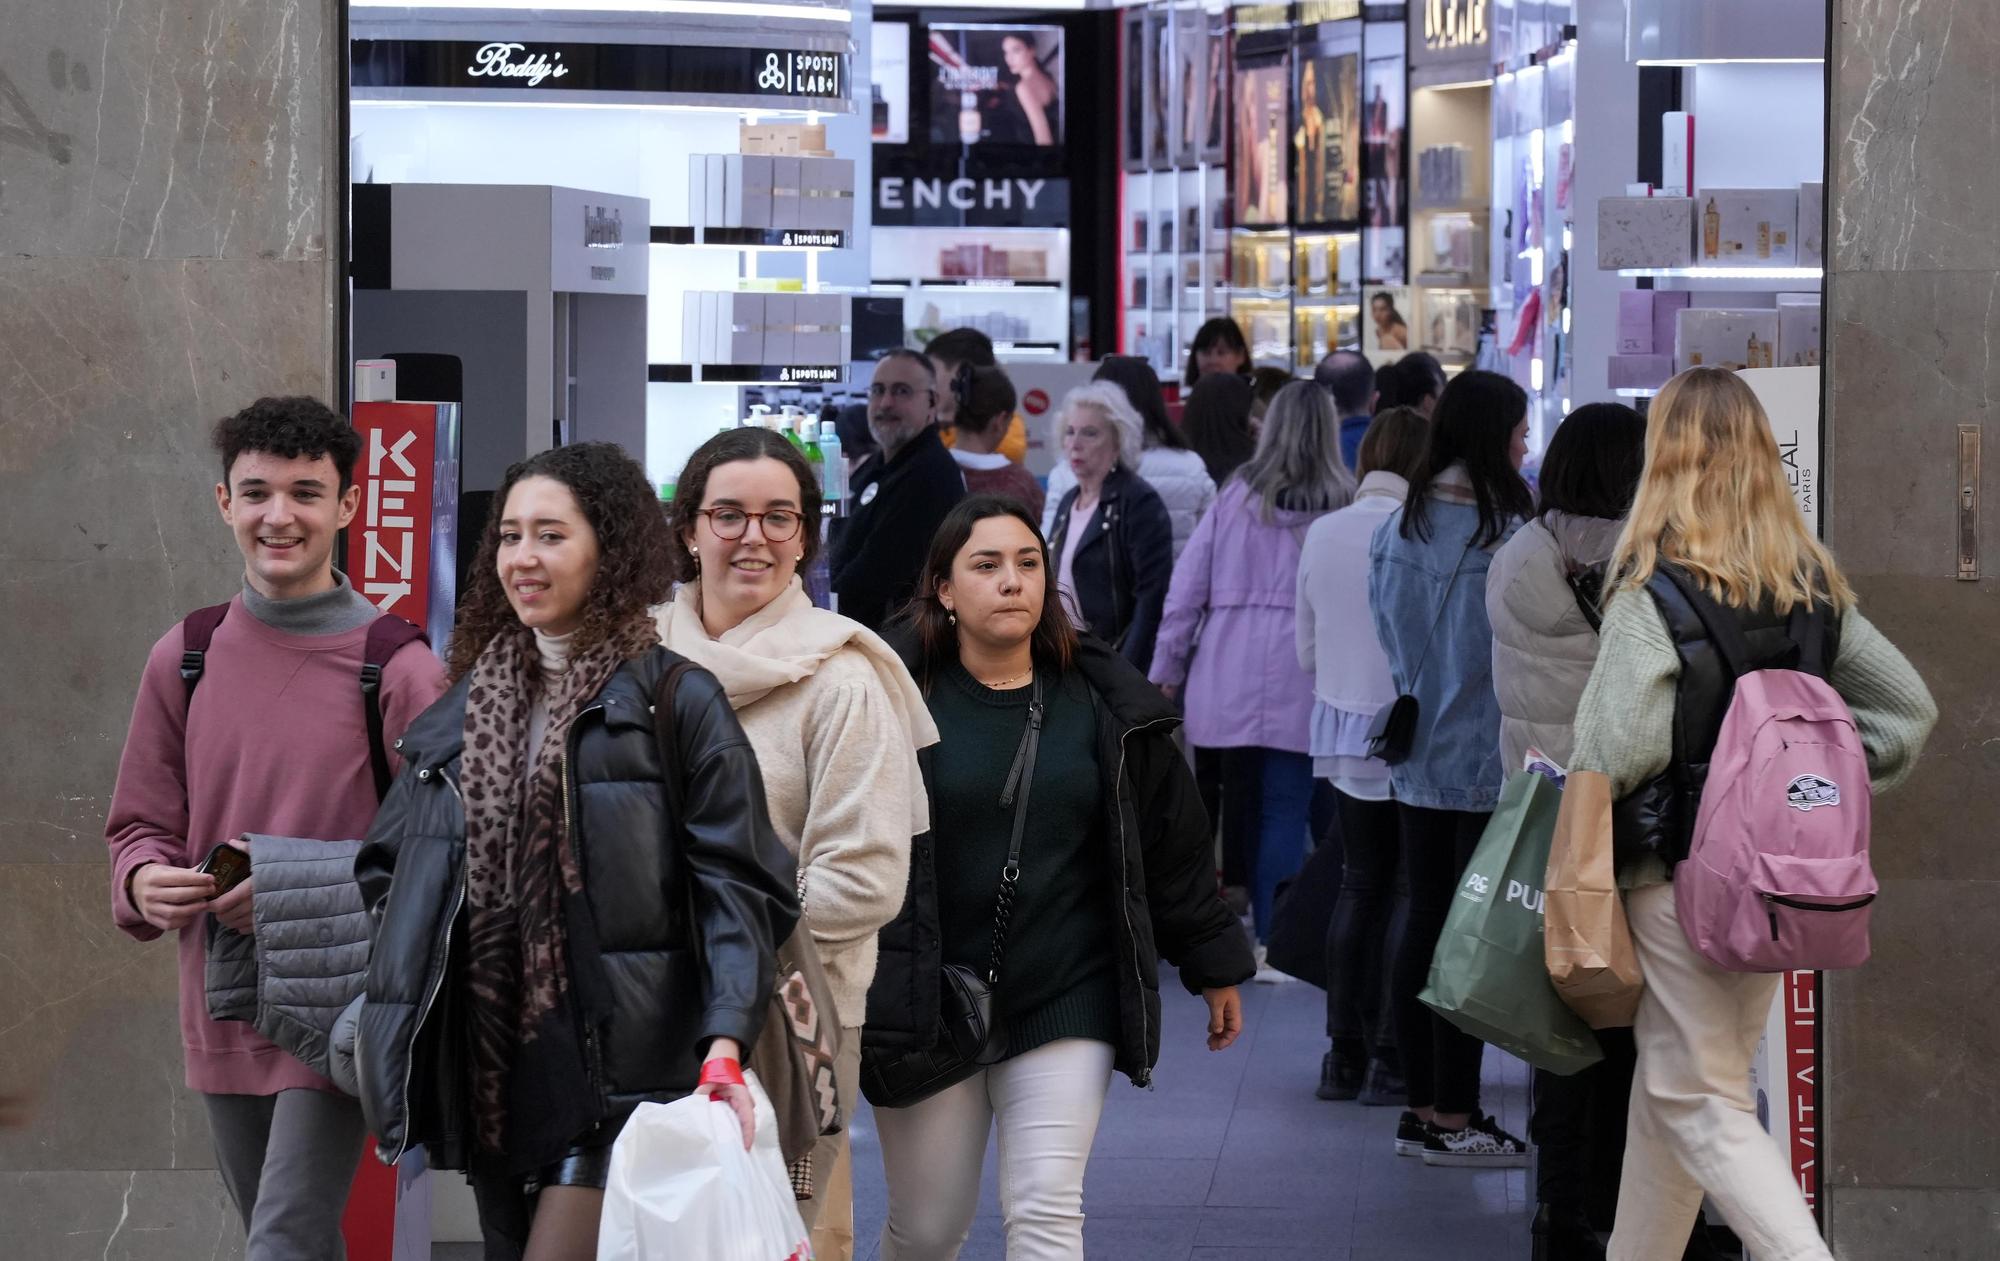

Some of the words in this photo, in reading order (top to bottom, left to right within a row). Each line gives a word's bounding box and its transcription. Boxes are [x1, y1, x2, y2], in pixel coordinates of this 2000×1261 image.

[467, 43, 568, 86] Boddy's
[797, 55, 833, 71] SPOTS
[797, 75, 833, 92] LAB+
[879, 177, 1045, 209] ENCHY
[799, 235, 820, 244] SPOTS
[796, 370, 818, 379] SPOTS
[1779, 430, 1799, 496] EAL
